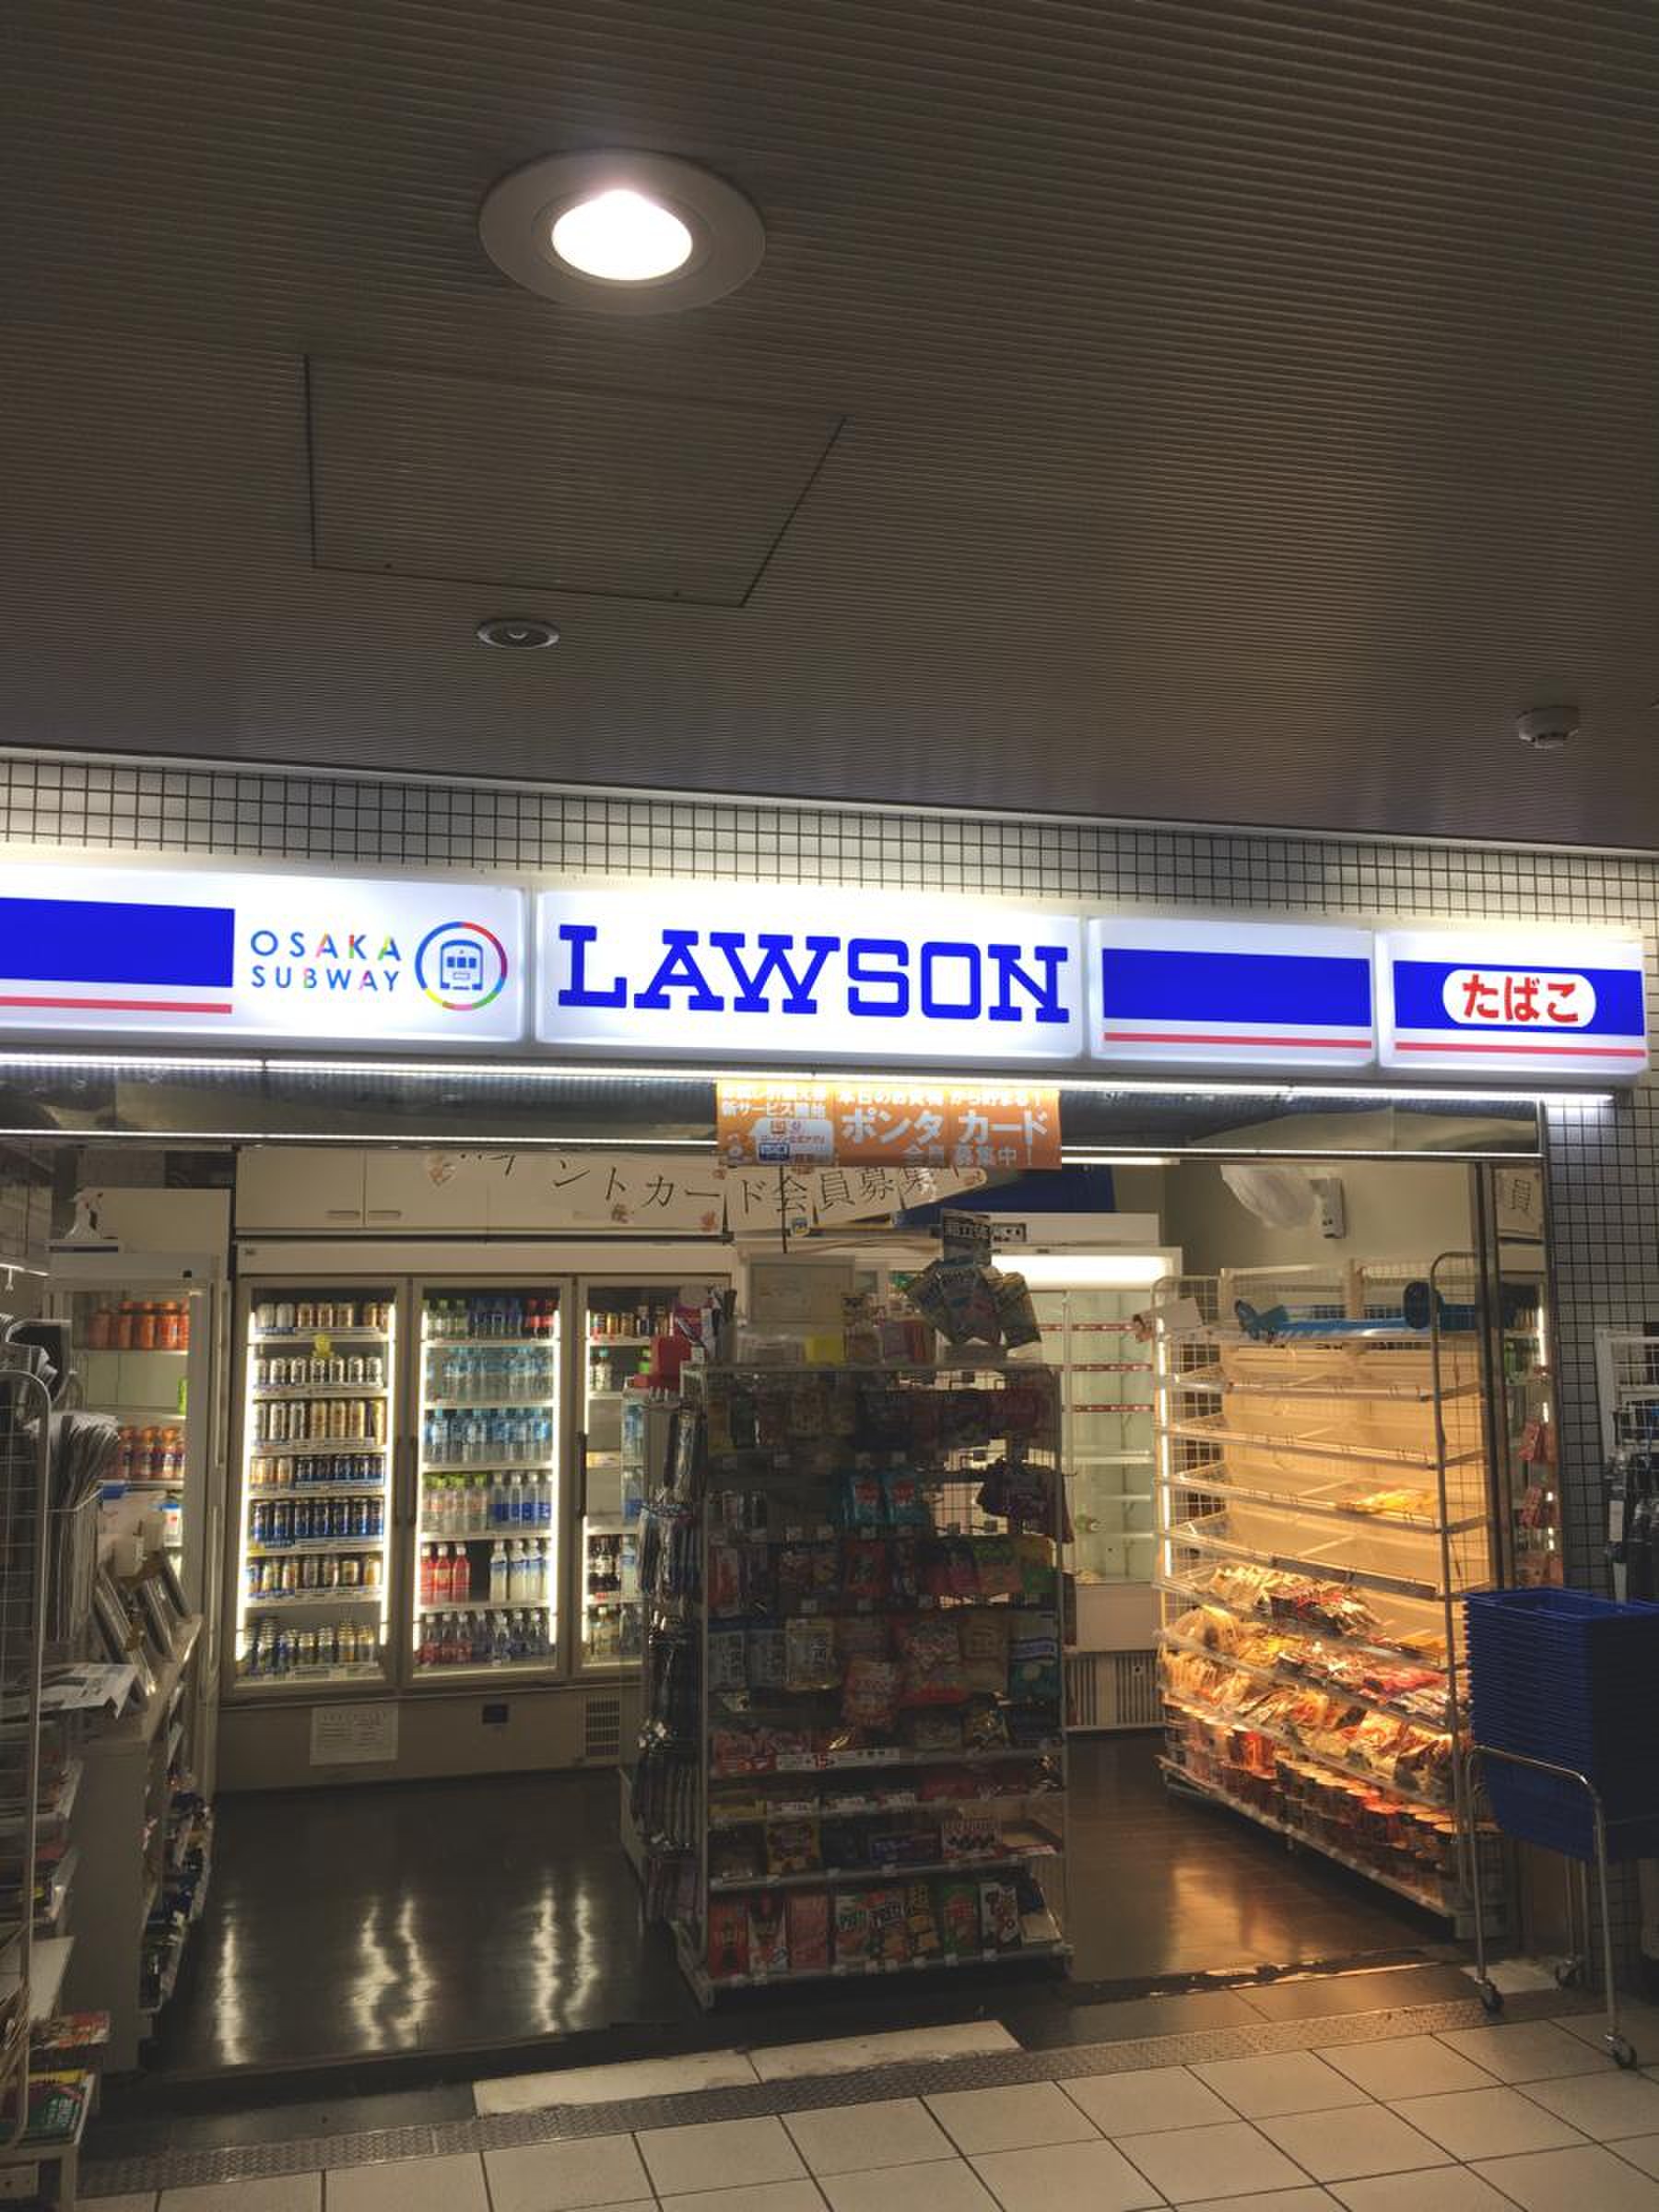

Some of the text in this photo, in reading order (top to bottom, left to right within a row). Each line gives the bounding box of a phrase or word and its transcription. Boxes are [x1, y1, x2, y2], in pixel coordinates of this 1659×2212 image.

[250, 929, 402, 961] OSAKA
[251, 964, 400, 992] SUBWAY
[558, 924, 1070, 1023] LAWSON
[1462, 972, 1579, 1023] たばこ
[841, 1108, 1048, 1146] ポンタ カード
